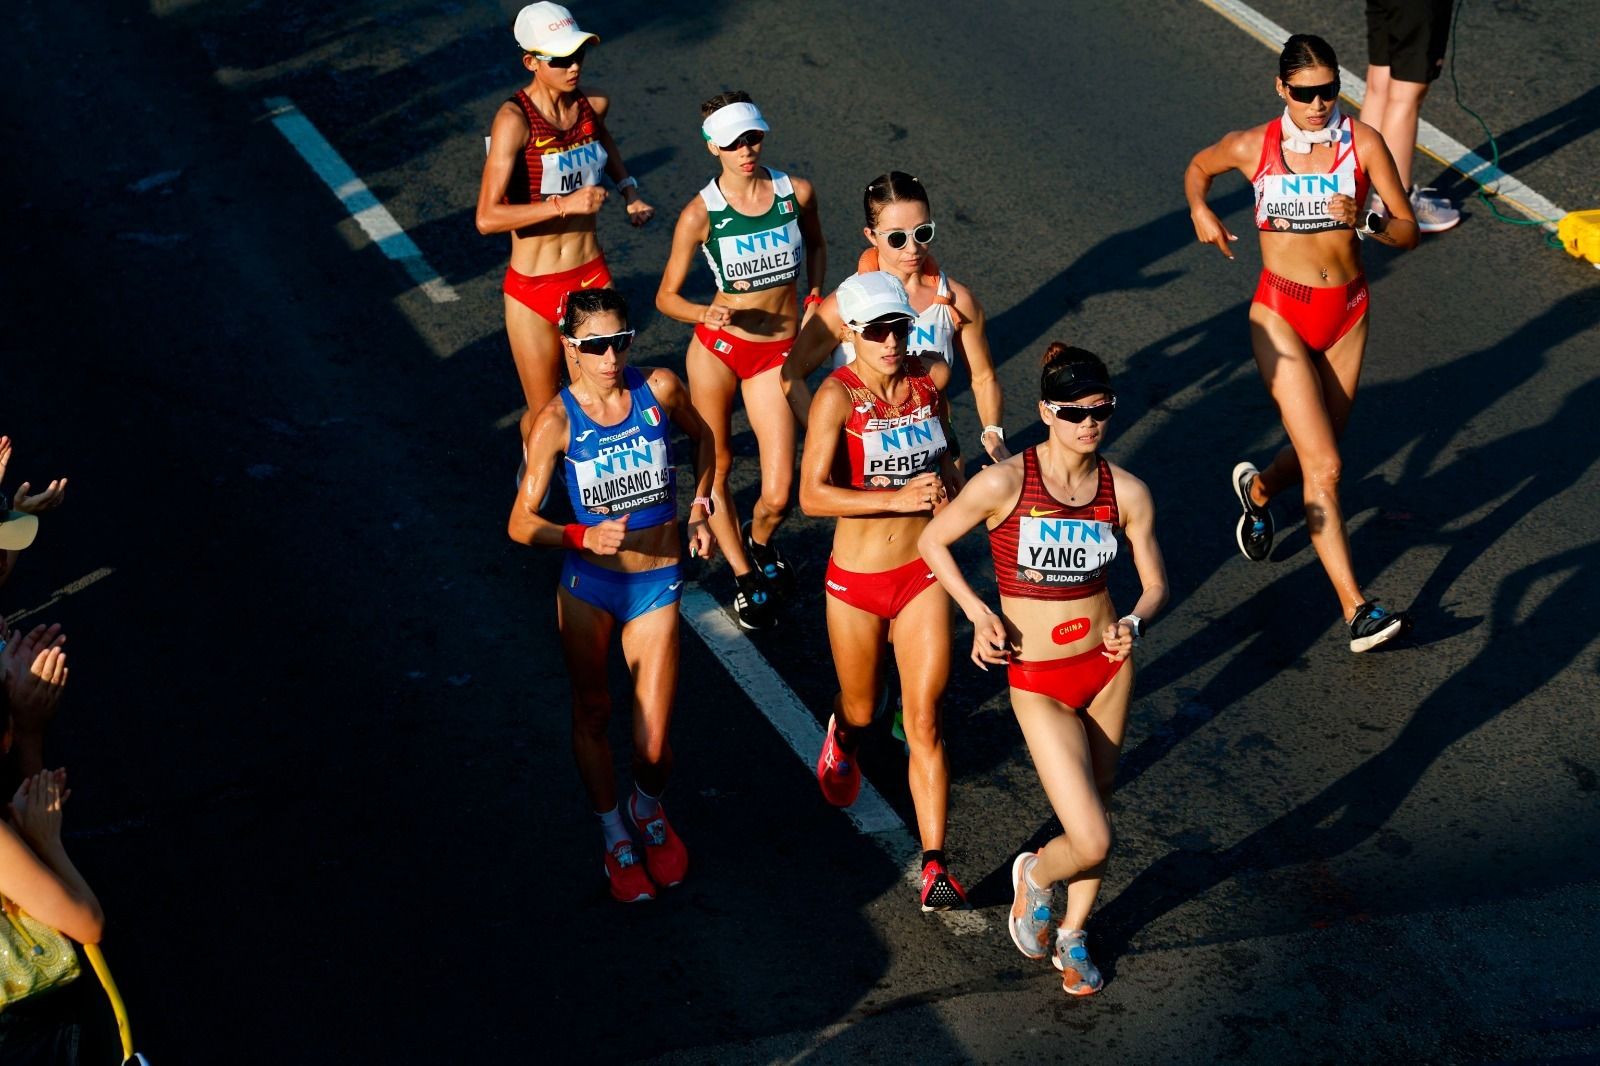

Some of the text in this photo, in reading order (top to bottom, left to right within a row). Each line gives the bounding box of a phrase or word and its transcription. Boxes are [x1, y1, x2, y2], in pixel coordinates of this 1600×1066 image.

[557, 143, 598, 172] NTN
[561, 171, 583, 191] MA
[1281, 174, 1338, 195] NTN
[1267, 198, 1329, 216] GARCÍA LEÓ
[1292, 221, 1338, 230] BUDAPEST
[735, 226, 790, 256] NTN
[726, 252, 790, 278] GONZÁLEZ
[753, 271, 796, 287] BUDAPEST
[907, 324, 935, 346] TN
[864, 404, 932, 431] ESPAÑA
[598, 435, 649, 458] ITALIA
[881, 420, 933, 452] NTN
[594, 445, 653, 479] NTN
[870, 450, 930, 472] PÉREZ
[583, 470, 652, 505] PALMISANO
[611, 493, 659, 512] BUDAPEST
[1040, 520, 1101, 544] NTN
[1029, 547, 1114, 568] YANG 114
[1060, 623, 1082, 635] CHINA
